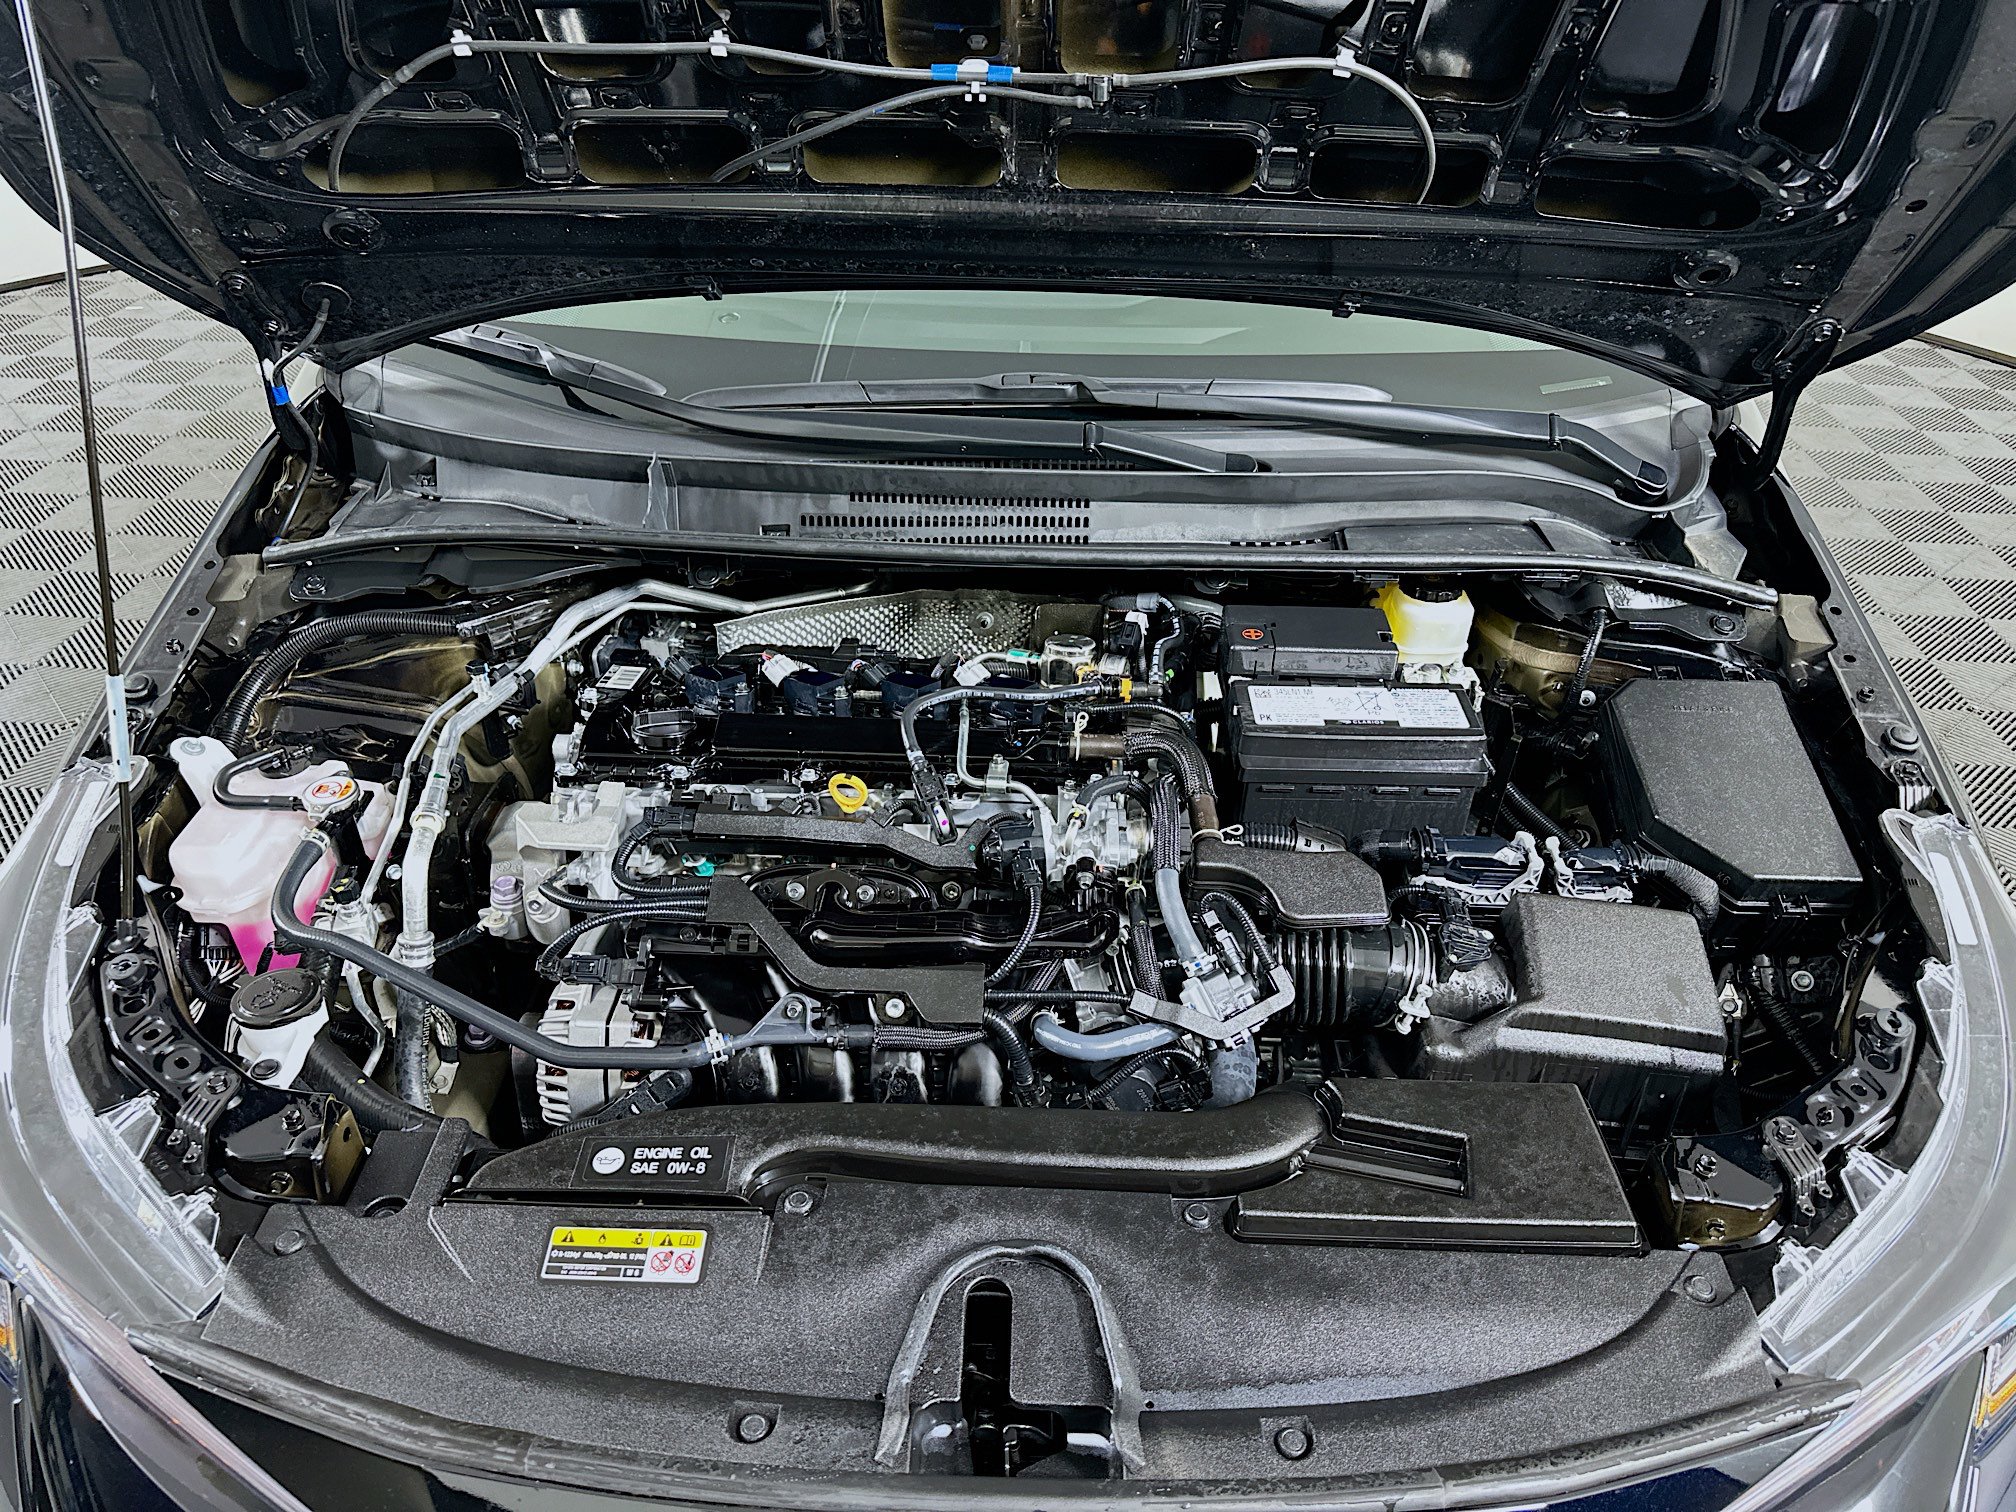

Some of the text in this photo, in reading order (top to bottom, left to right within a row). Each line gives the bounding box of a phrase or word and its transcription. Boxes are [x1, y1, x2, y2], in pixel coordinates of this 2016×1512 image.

[1259, 713, 1273, 722] PK
[633, 1146, 713, 1160] ENGINE OIL
[630, 1161, 707, 1175] SAE 0W-8
